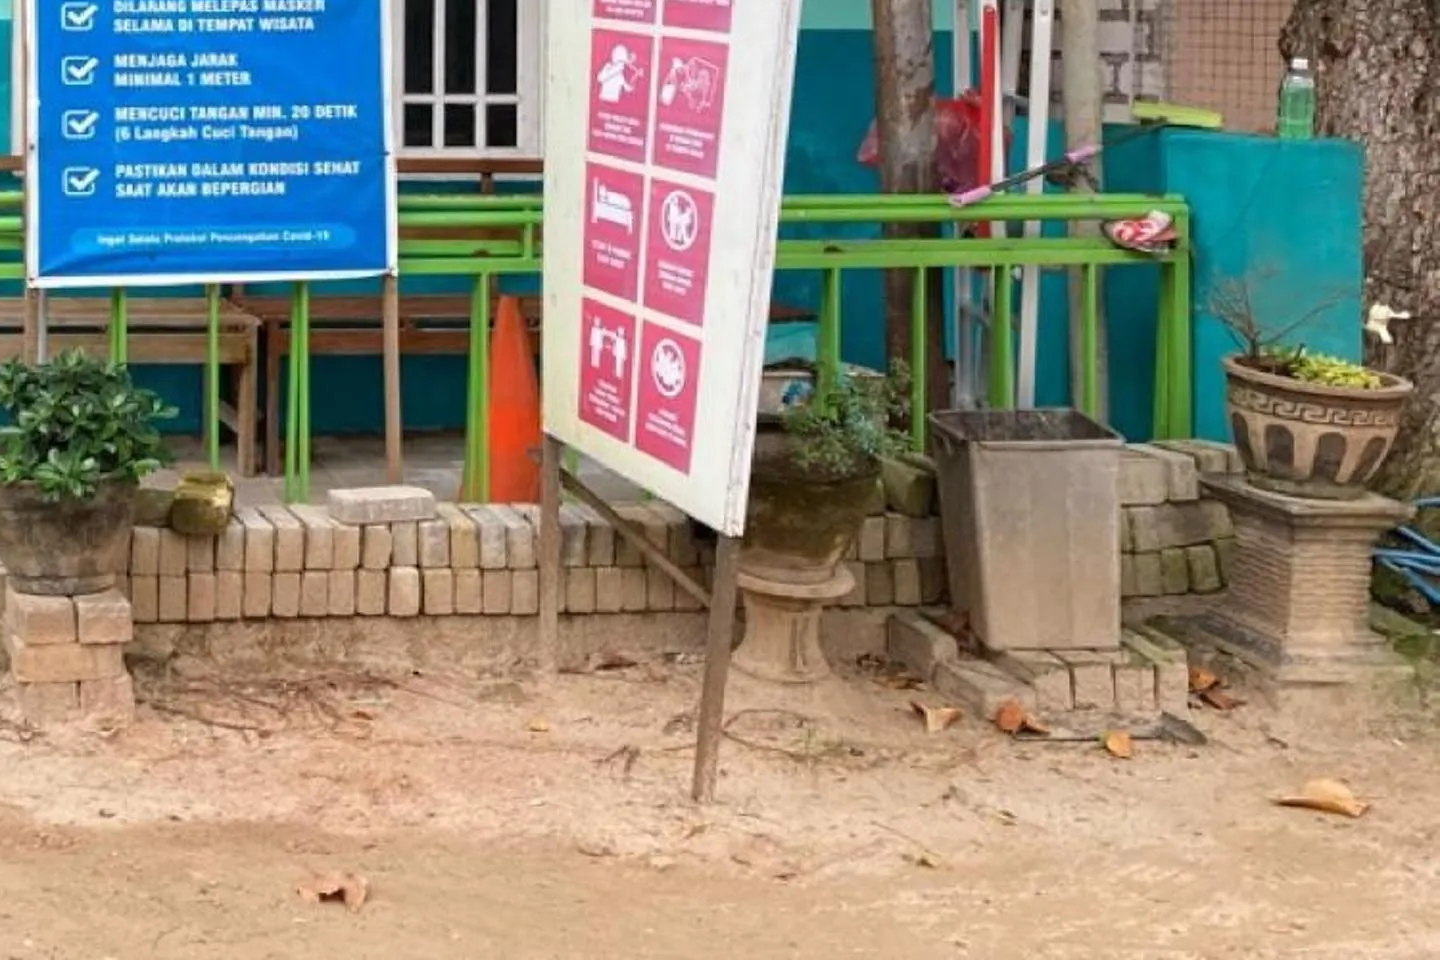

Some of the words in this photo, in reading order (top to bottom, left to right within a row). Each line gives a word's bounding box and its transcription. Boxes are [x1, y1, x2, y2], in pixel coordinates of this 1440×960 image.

[113, 0, 186, 13] DILARANG
[191, 0, 259, 12] MELEPAS
[113, 18, 174, 33] SELAMA
[178, 18, 193, 32] DI
[198, 18, 254, 32] TEMPAT
[258, 17, 315, 31] WISATA
[113, 53, 187, 68] MENJAGA
[191, 53, 238, 68] JARAK
[113, 72, 181, 86] MINIMAL
[187, 72, 194, 86] 1
[199, 71, 252, 86] METER
[114, 106, 185, 121] MENCUCI
[189, 105, 249, 120] TANGAN
[253, 105, 287, 120] MIN.
[291, 105, 310, 119] 20
[315, 104, 358, 119] DETIK
[115, 126, 131, 142] (6
[135, 126, 198, 142] Langkah
[202, 125, 235, 139] Cuci
[239, 125, 299, 141] Tangan)
[115, 163, 187, 179] PASTIKAN
[191, 162, 245, 177] DALAM
[248, 161, 309, 176] KONDISI
[313, 161, 361, 175] SEHAT
[115, 183, 153, 198] SAAT
[157, 182, 197, 197] AKAN
